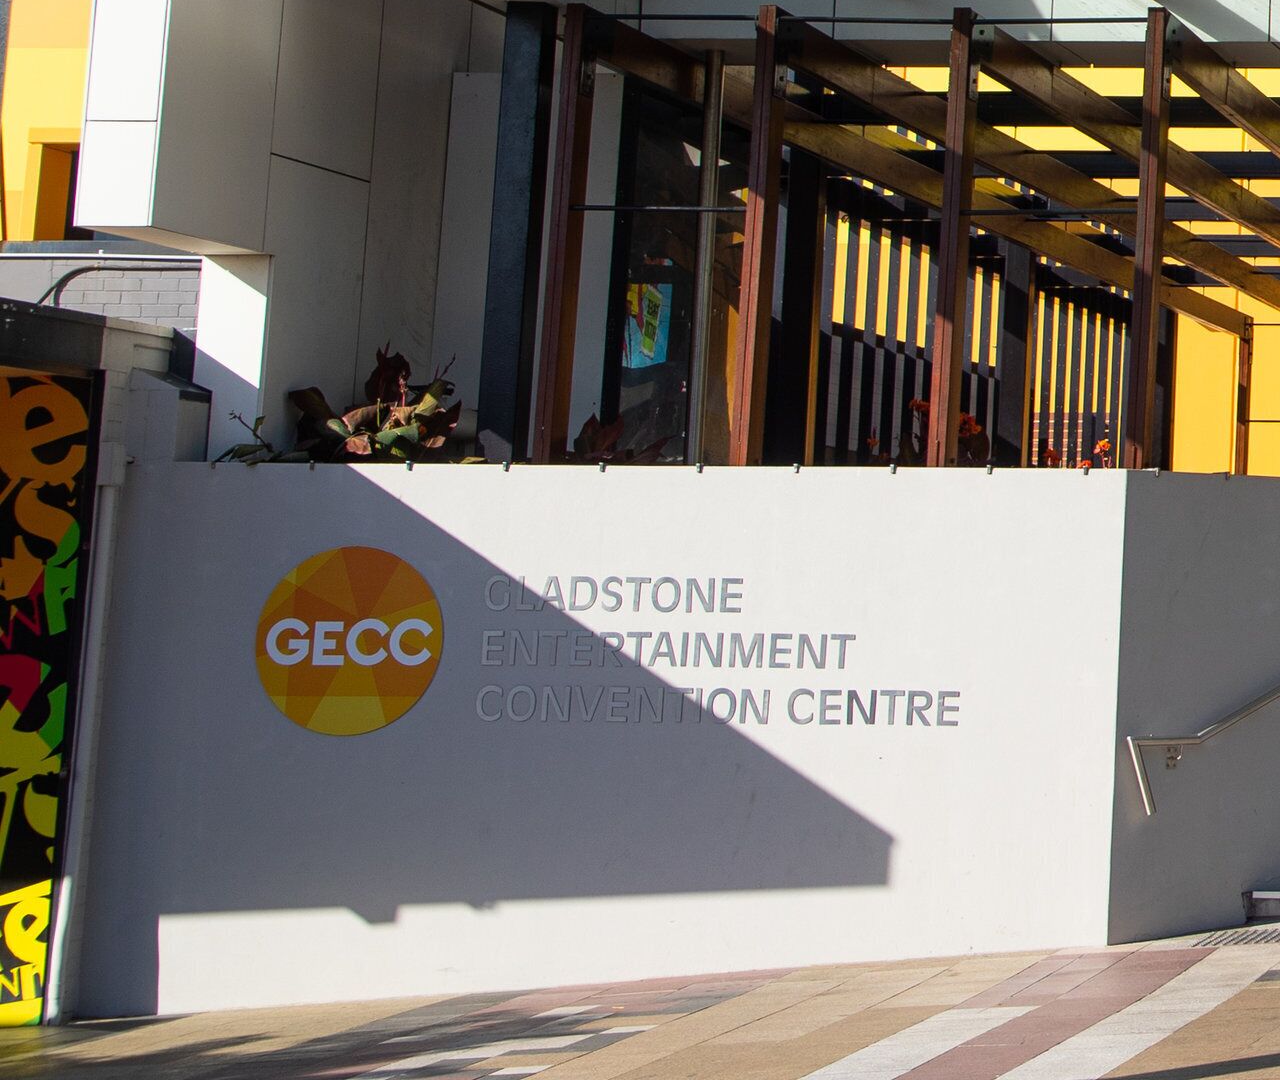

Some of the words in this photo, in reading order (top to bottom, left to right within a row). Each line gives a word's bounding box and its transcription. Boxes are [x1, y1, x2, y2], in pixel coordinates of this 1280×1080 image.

[484, 575, 744, 613] GLADSTONE
[265, 617, 434, 666] GECC
[479, 629, 857, 670] ENTERTAINMENT
[475, 684, 771, 725] CONVENTION
[787, 688, 961, 727] CENTRE
